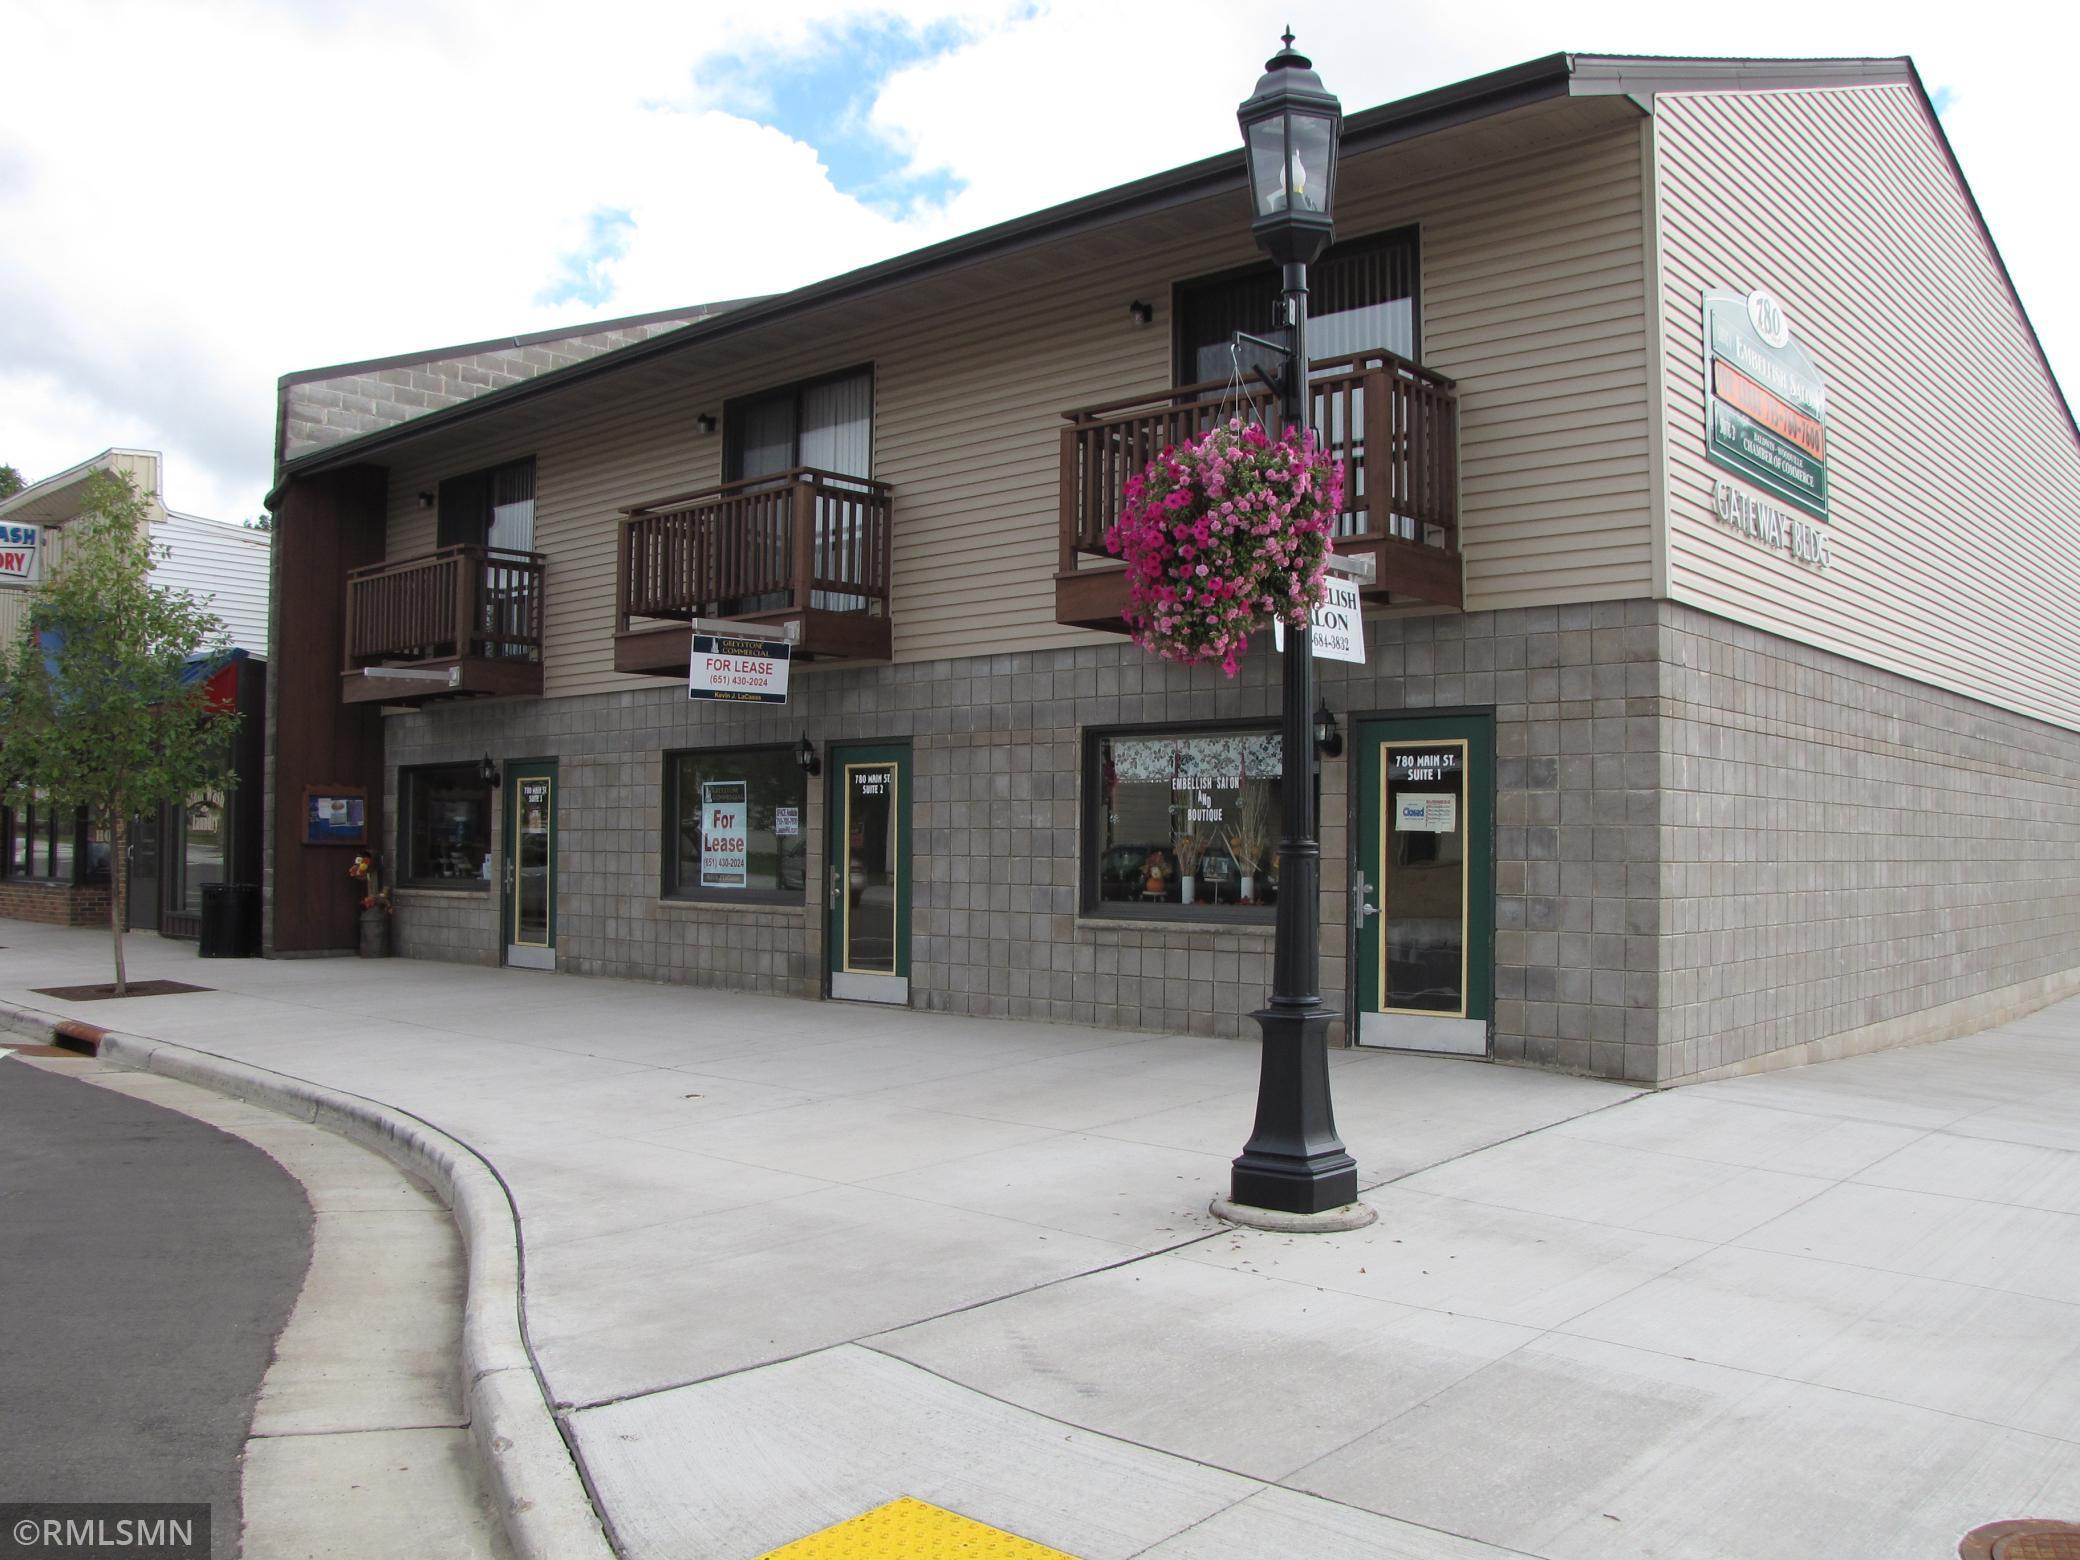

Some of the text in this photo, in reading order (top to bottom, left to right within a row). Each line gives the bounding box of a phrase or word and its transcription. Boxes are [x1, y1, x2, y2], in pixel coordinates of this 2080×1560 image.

[1756, 297, 1782, 337] 780
[1743, 437, 1773, 466] CHAMBER
[1781, 461, 1814, 488] COMMERCE
[1714, 480, 1786, 549] GATEWAY
[1324, 587, 1357, 610] LISH
[722, 647, 769, 657] COMMERCIAL
[706, 658, 774, 675] FOR LEASE
[710, 674, 768, 687] (651) 430-2024
[1395, 754, 1456, 767] 780 MAIN ST.
[1407, 768, 1434, 781] SUITE
[862, 784, 879, 794] SUITE
[1172, 777, 1212, 790] EMBELLISH
[1197, 789, 1212, 809] AND
[713, 809, 735, 829] For
[1187, 808, 1223, 822] BOUTIQUE
[1402, 806, 1425, 817] Closed
[703, 832, 745, 853] Lease
